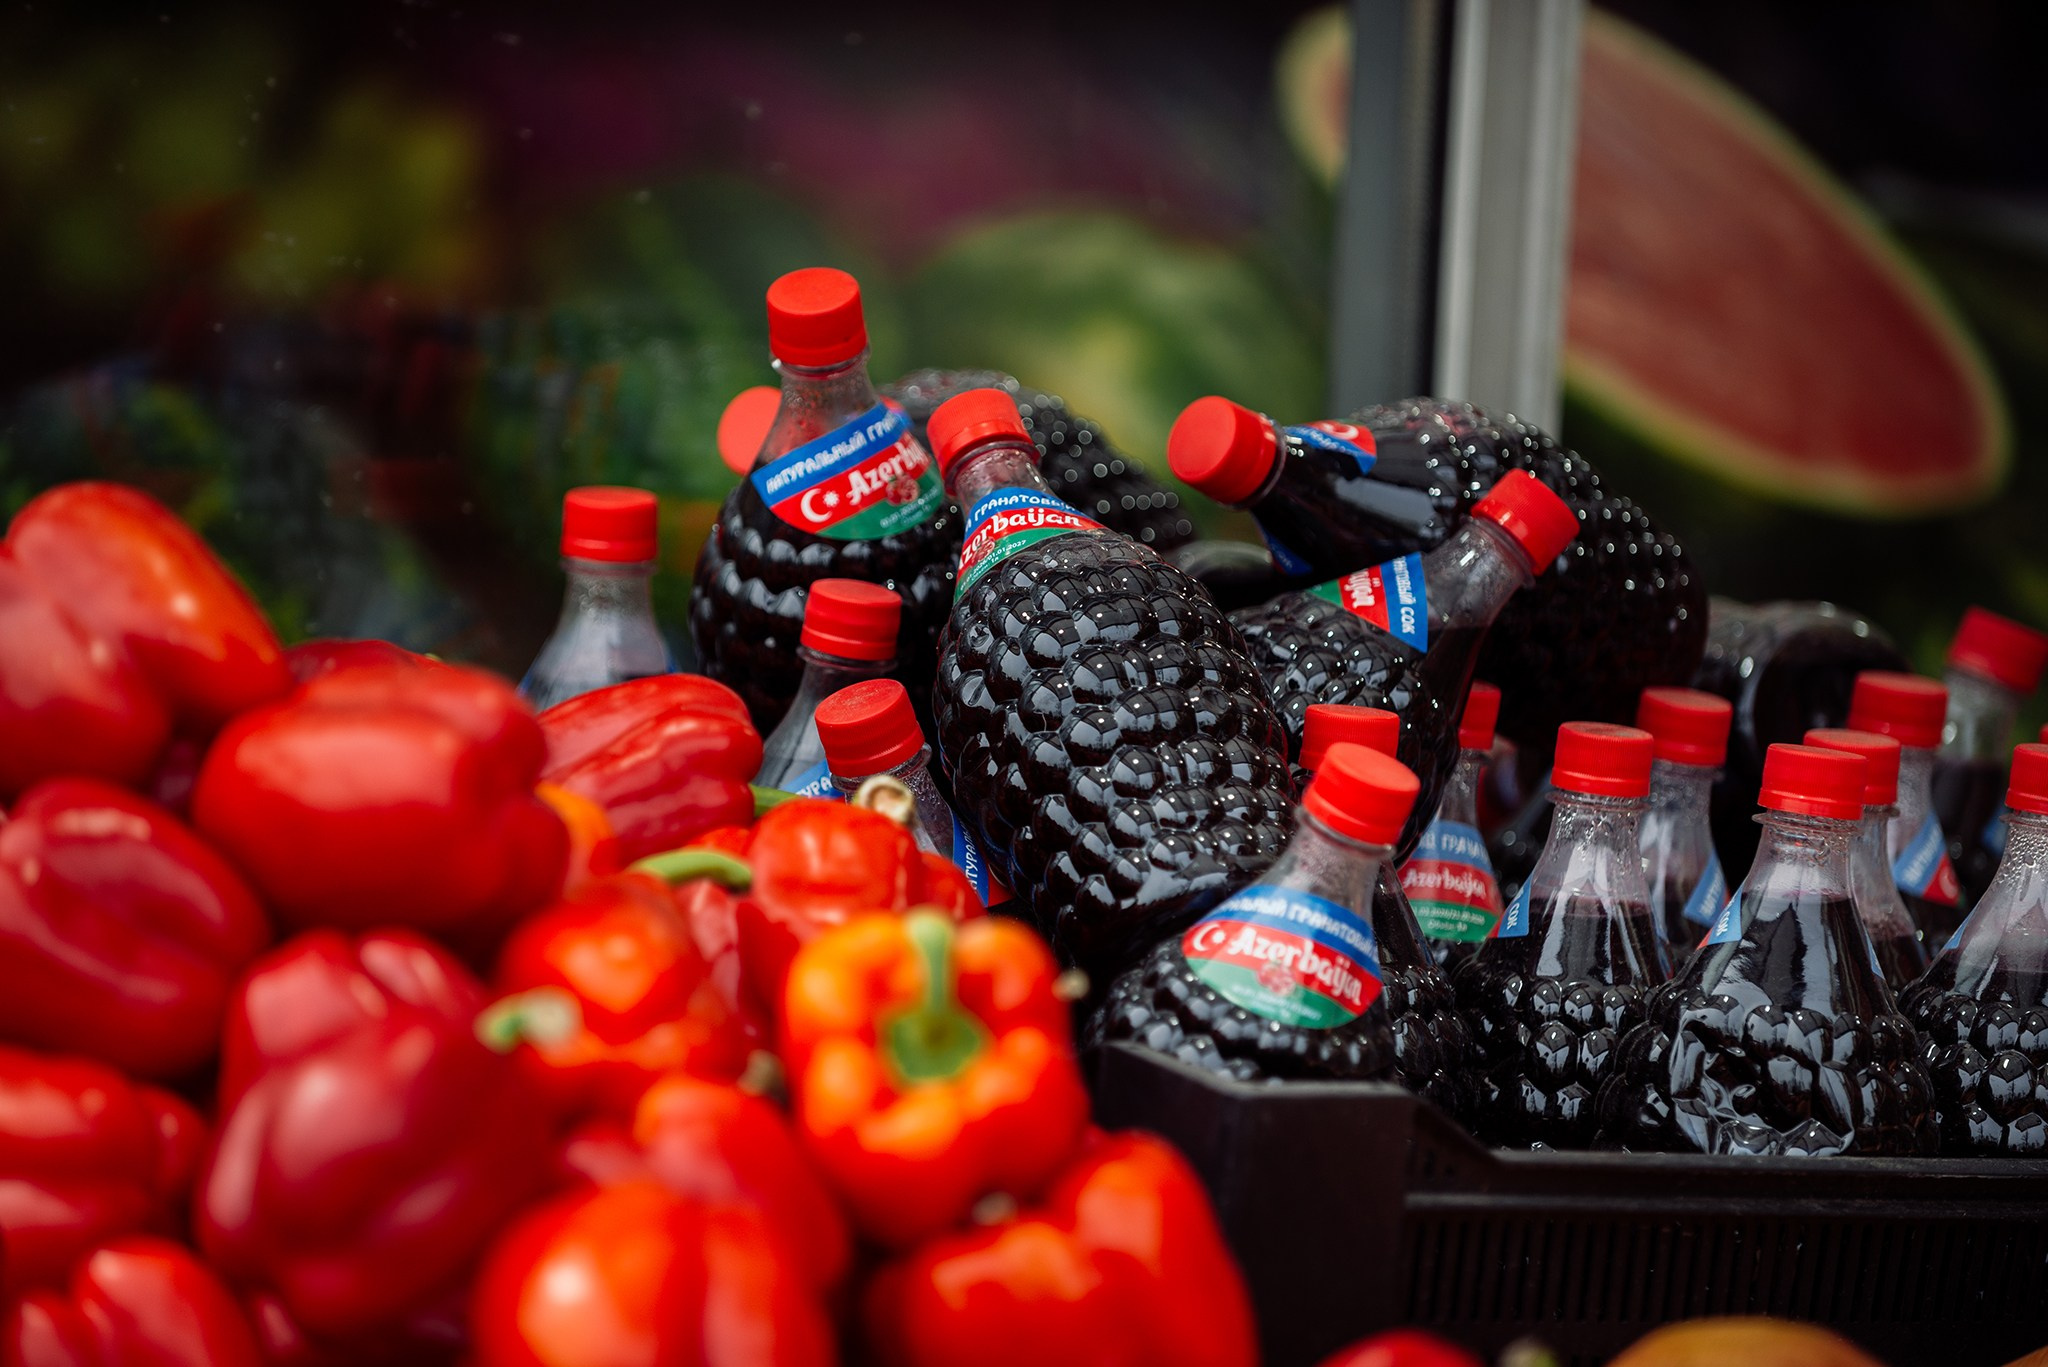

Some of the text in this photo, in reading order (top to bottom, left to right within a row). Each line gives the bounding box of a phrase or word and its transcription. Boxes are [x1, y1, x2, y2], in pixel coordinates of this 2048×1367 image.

[766, 430, 867, 494] НАТУРАЛЬНЫЙ
[1400, 606, 1415, 635] СОК
[1507, 902, 1520, 930] СОК
[1716, 911, 1731, 937] СОК
[1228, 927, 1363, 1006] Azerbaijan
